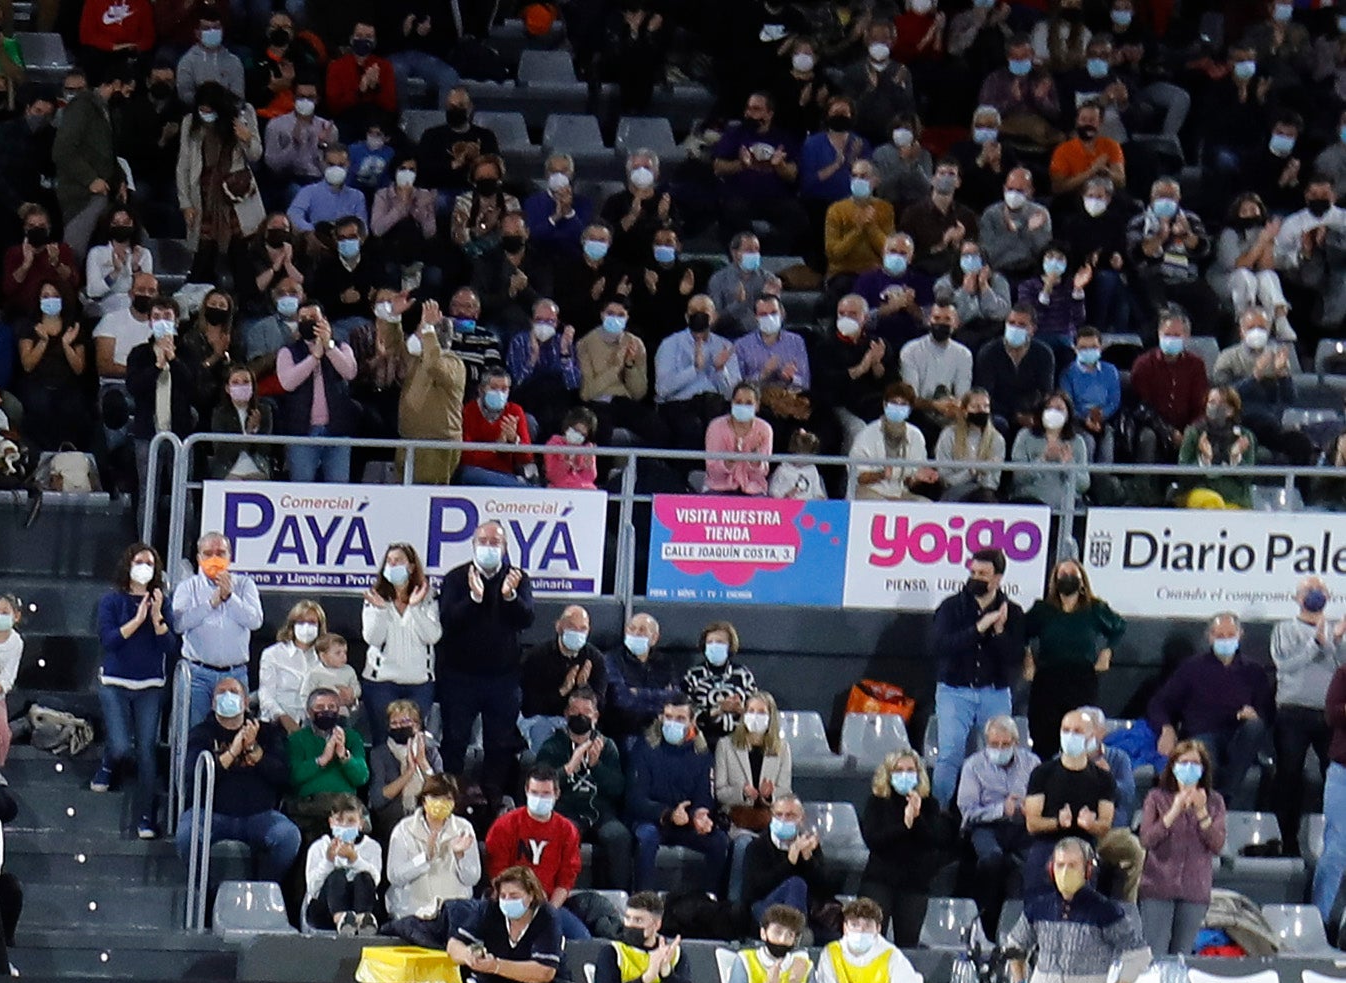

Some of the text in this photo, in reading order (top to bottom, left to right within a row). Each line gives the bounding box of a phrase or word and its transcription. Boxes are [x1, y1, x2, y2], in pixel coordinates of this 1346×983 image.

[279, 495, 355, 511] Comercial
[484, 500, 560, 516] Comercial
[675, 507, 782, 526] VISITA NUESTRA
[223, 491, 377, 567] PAYÁ
[426, 496, 581, 571] PYÁ
[704, 525, 751, 542] TIENDA
[868, 514, 1042, 569] yoigo
[664, 545, 695, 557] CALLE
[698, 545, 740, 559] JOAQUÍN
[743, 548, 781, 562] COSTA,
[1122, 527, 1346, 575] Diario Pale
[275, 574, 284, 584] y
[287, 572, 341, 586] Limpieza
[345, 573, 378, 586] Profe
[532, 578, 573, 590] uinaria
[885, 578, 931, 593] PIENSO,
[1156, 587, 1297, 604] Cuando el compromis
[516, 838, 549, 866] NY
